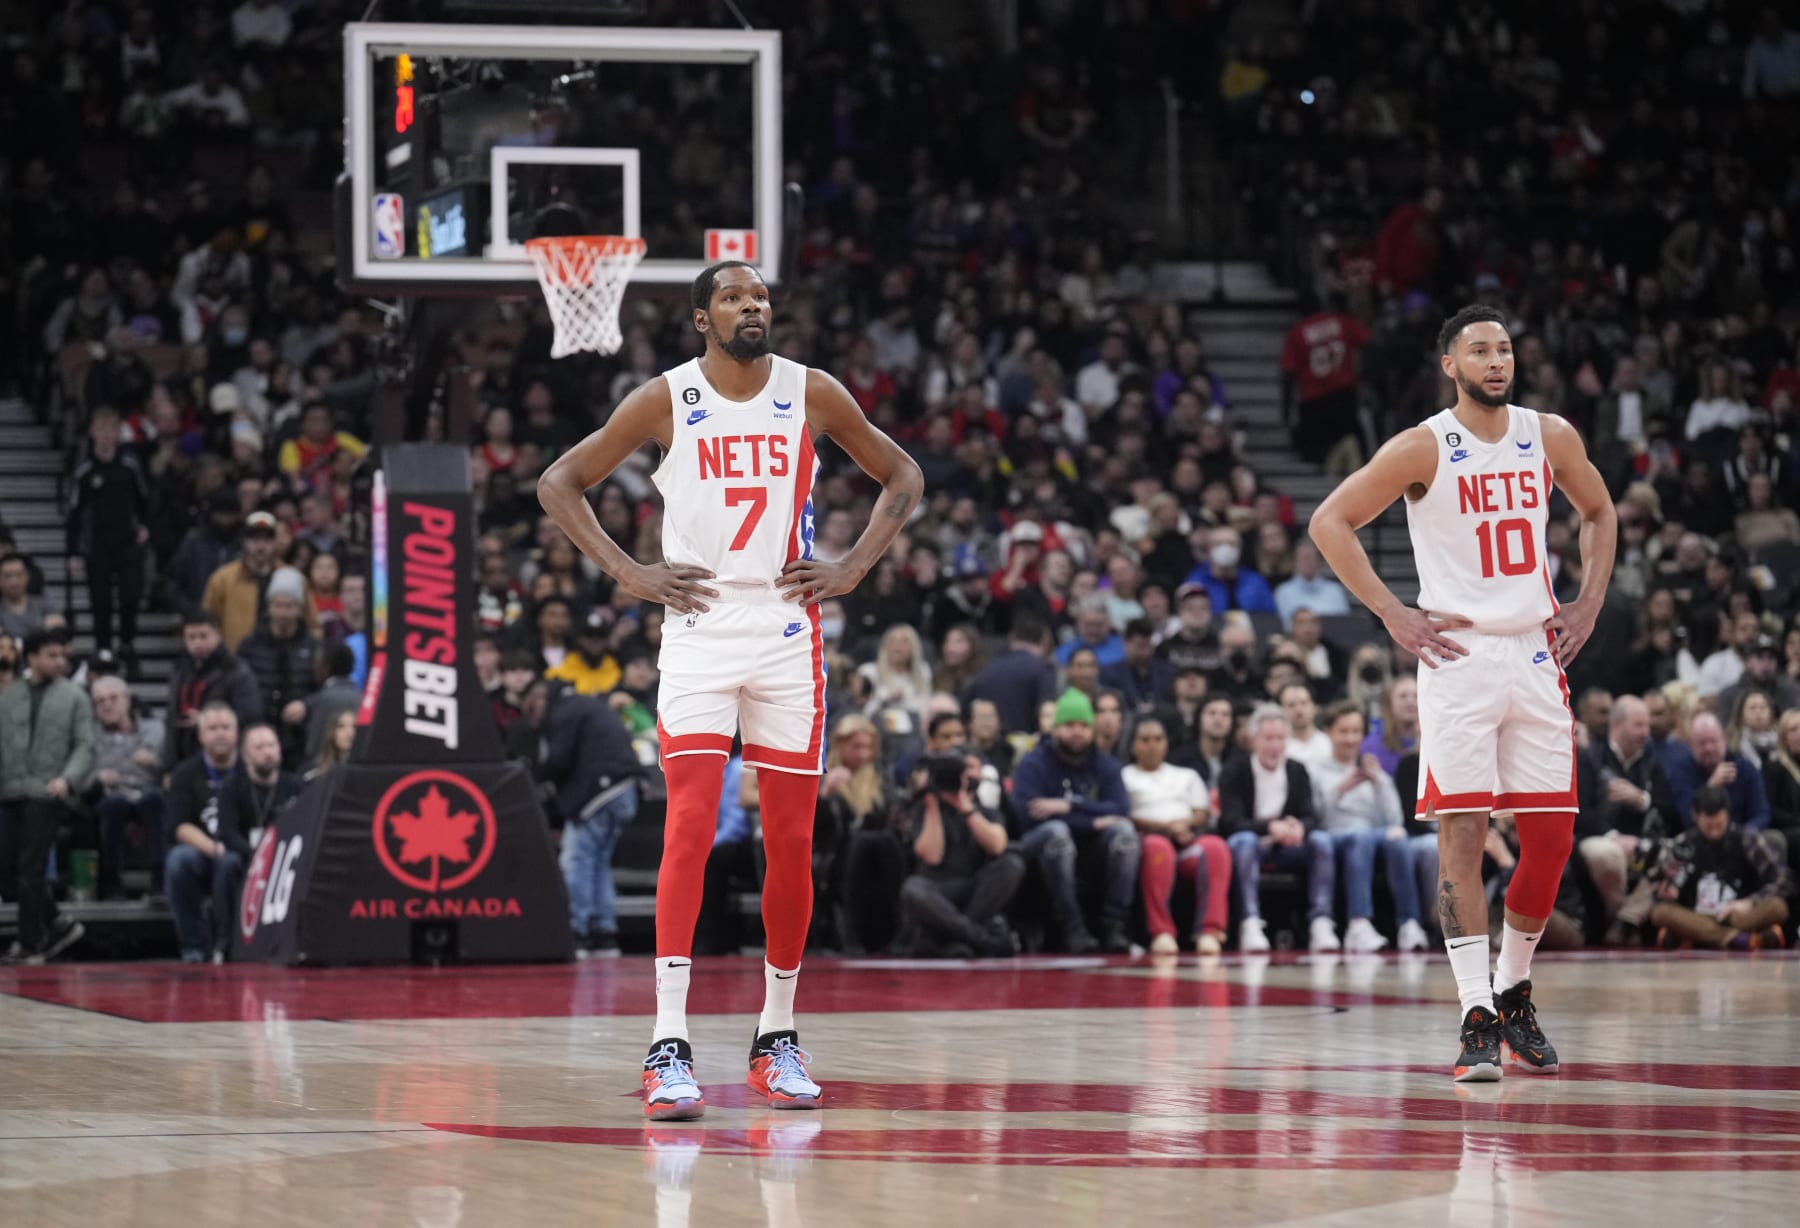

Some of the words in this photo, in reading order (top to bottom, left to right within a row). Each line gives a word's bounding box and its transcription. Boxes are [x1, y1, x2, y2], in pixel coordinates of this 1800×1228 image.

[686, 390, 698, 403] 6
[773, 412, 793, 420] Webull
[697, 434, 789, 480] NETS
[1447, 434, 1460, 446] 6
[1457, 470, 1539, 515] NETS
[724, 486, 768, 551] 7
[1475, 517, 1537, 578] 10
[403, 501, 459, 749] POINTSBET
[261, 833, 303, 925] LG
[350, 899, 398, 918] AIR
[403, 898, 522, 918] CANADA
